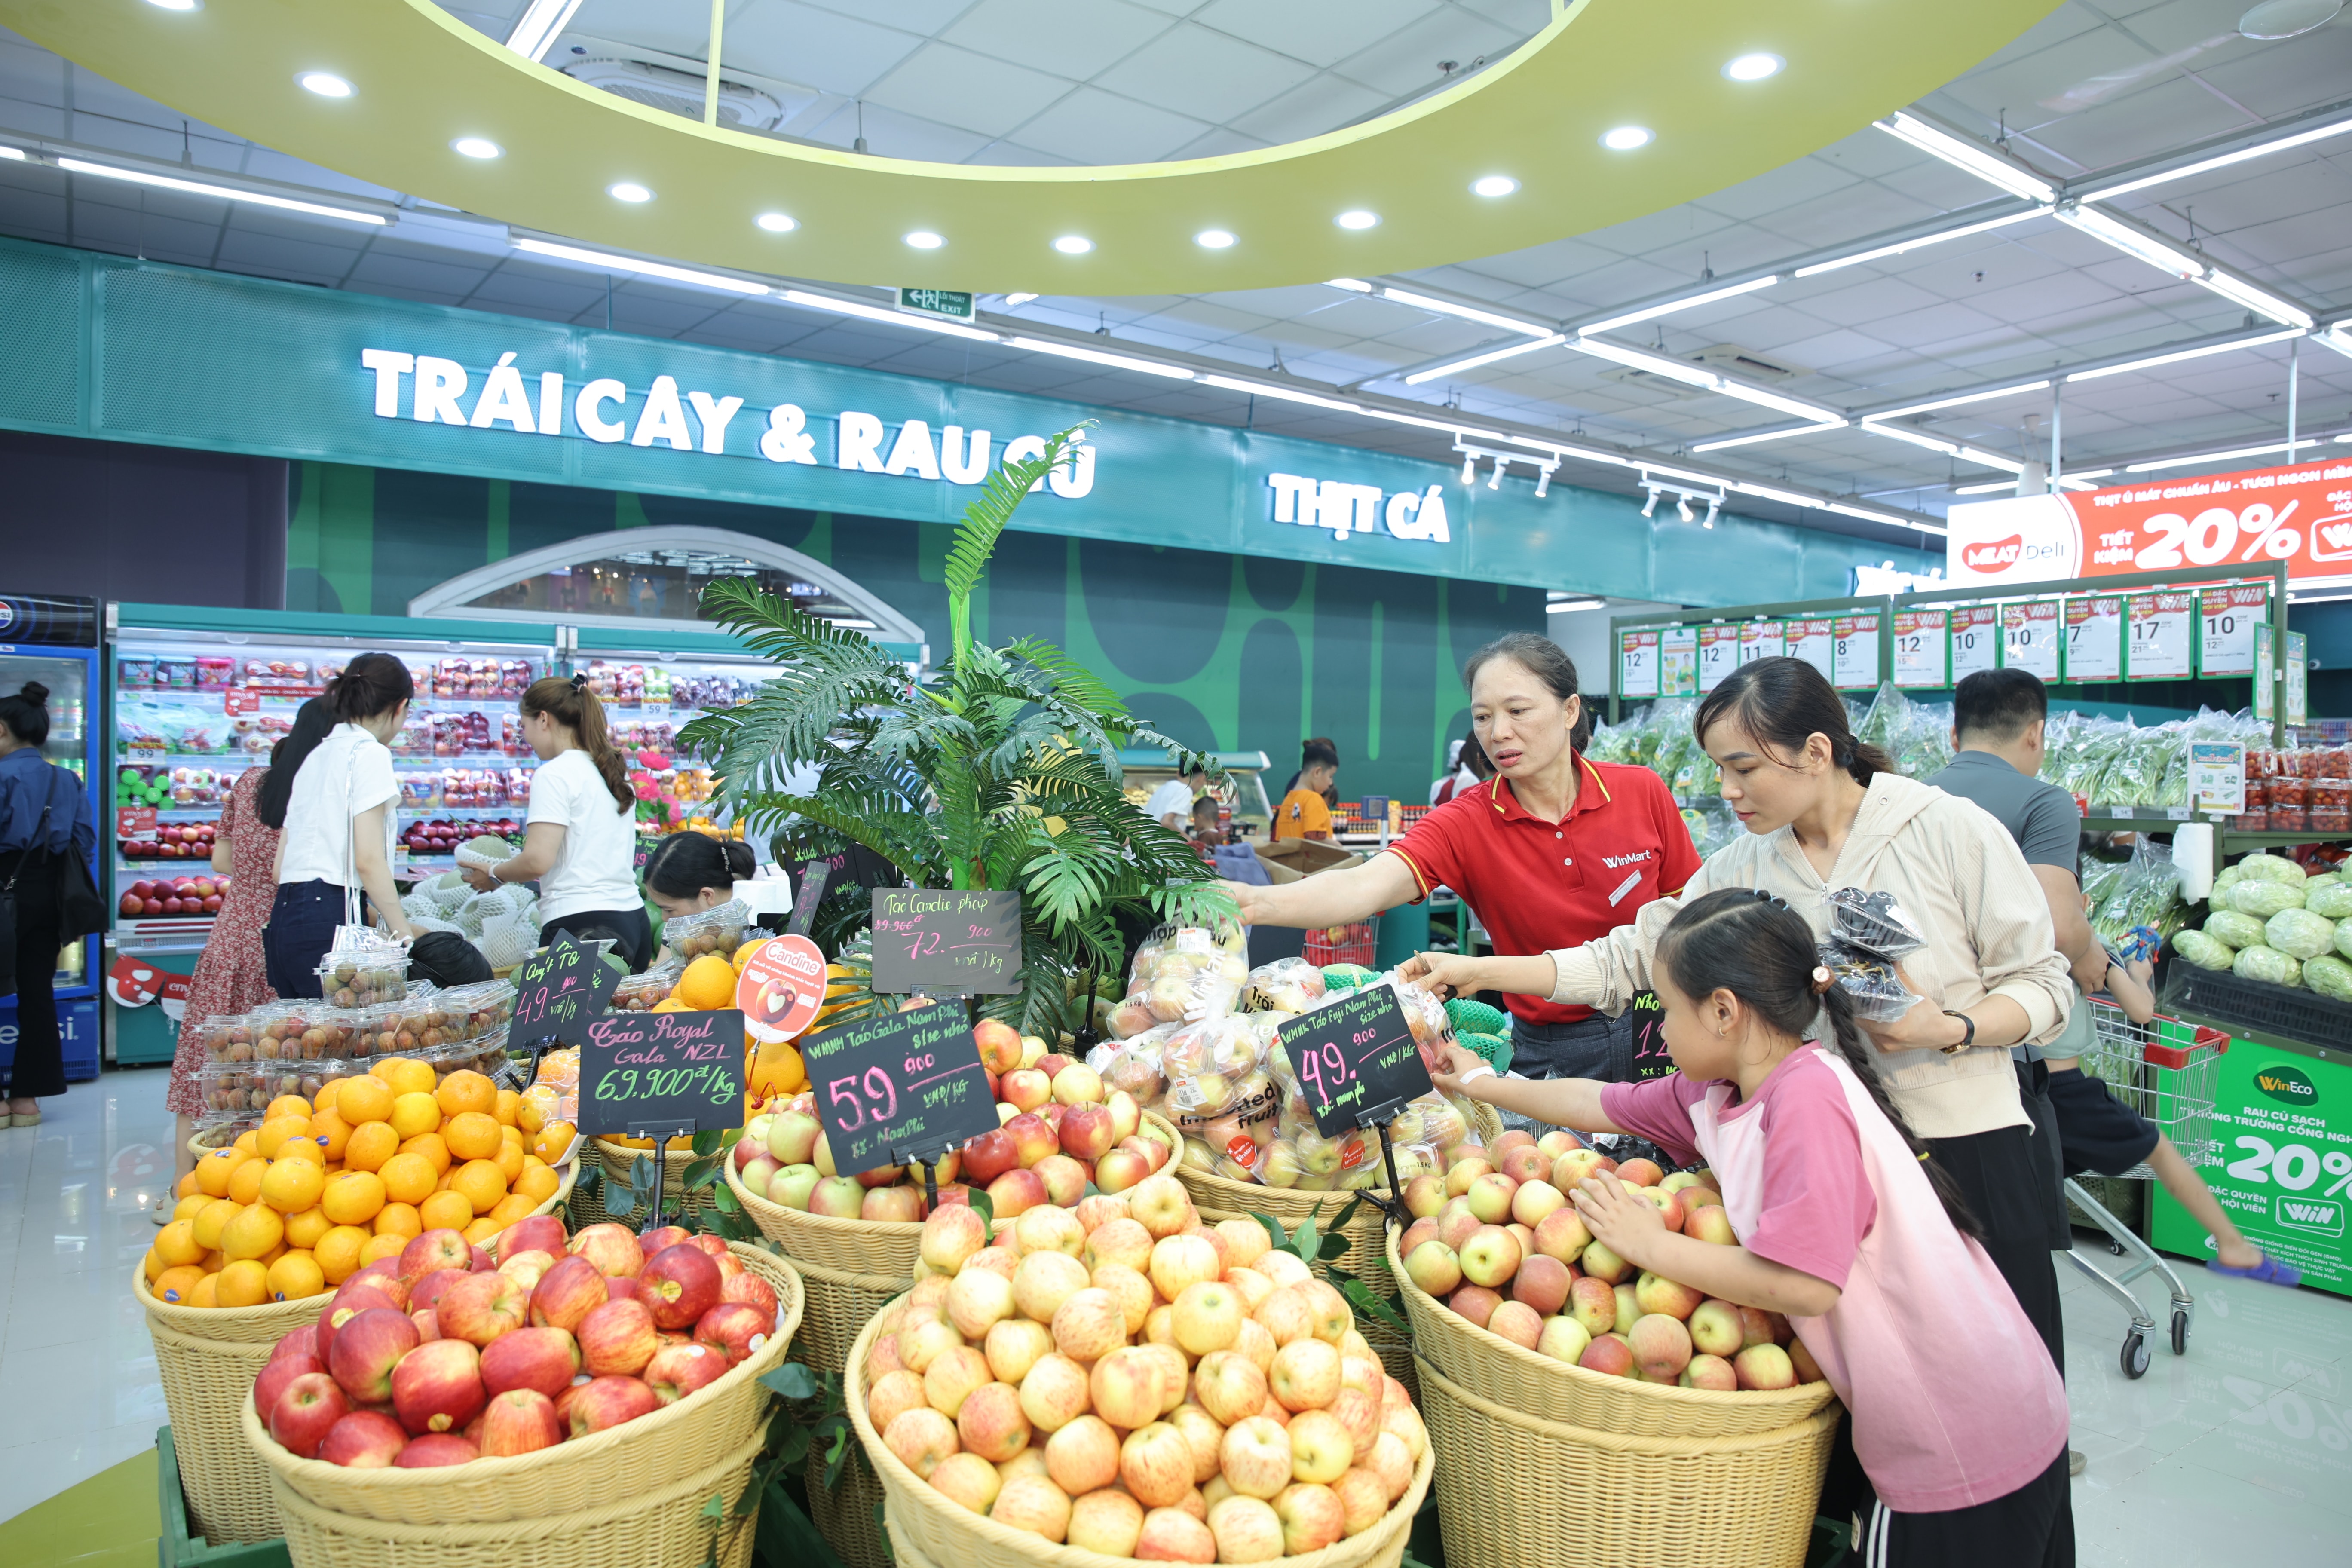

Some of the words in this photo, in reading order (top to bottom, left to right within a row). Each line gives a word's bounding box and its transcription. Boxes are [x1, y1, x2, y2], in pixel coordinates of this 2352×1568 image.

[941, 304, 962, 315] EXIT
[362, 348, 564, 435] TRÁI
[575, 375, 744, 456] CÂY
[760, 403, 818, 466] &
[838, 410, 991, 486] RAU
[2093, 493, 2122, 507] THỊT
[2134, 487, 2162, 502] MÁT
[2211, 479, 2232, 493] ÂU
[2277, 470, 2321, 485] NGON
[1268, 472, 1382, 541] THỊT
[1385, 484, 1450, 542] CÁ
[2099, 529, 2134, 548] TIẾT
[2135, 499, 2301, 569] 20%
[1968, 544, 2019, 566] MEAT
[2027, 542, 2064, 560] Deli
[2094, 548, 2133, 566] KIỆM
[2070, 626, 2081, 643] 7
[2133, 622, 2159, 640] 17
[2207, 616, 2235, 635] 10
[1898, 637, 1920, 653] 12
[1956, 634, 1974, 650] 10
[2008, 629, 2031, 646] 10
[1703, 648, 1719, 662] 12
[1788, 644, 1798, 657] 7
[1838, 641, 1847, 655] 8
[1626, 653, 1641, 667] 12
[649, 705, 661, 714] 59
[138, 749, 153, 758] 99
[1602, 849, 1651, 869] WinMart
[883, 894, 906, 916] Táo
[967, 924, 992, 939] 900
[767, 943, 819, 974] Candine
[748, 970, 768, 980] crunchy
[799, 994, 816, 1004] sweet
[1328, 1007, 1344, 1024] Fuji
[1345, 1000, 1366, 1016] Nam
[649, 1014, 714, 1049] Royal
[1353, 1027, 1376, 1046] 900
[614, 1045, 667, 1064] Gala
[682, 1043, 731, 1061] NZL
[2258, 1075, 2312, 1096] WinEco
[829, 1065, 897, 1132] 59
[1238, 1105, 1279, 1129] Fruit
[2234, 1116, 2285, 1132] TRƯỜNG
[2243, 1106, 2268, 1118] RAU
[2271, 1111, 2288, 1121] CỦ
[2291, 1115, 2326, 1128] SẠCH
[1235, 1145, 1254, 1163] WinMart
[2226, 1135, 2352, 1202] 20%
[2208, 1185, 2228, 1197] ĐẶC
[2230, 1189, 2267, 1204] QUYỀN
[2221, 1198, 2240, 1210] HỘI
[2242, 1202, 2267, 1215] VIÊN
[2280, 1249, 2294, 1258] KÍCH
[2313, 1257, 2328, 1265] SINH
[2323, 1253, 2342, 1262] (GMO)
